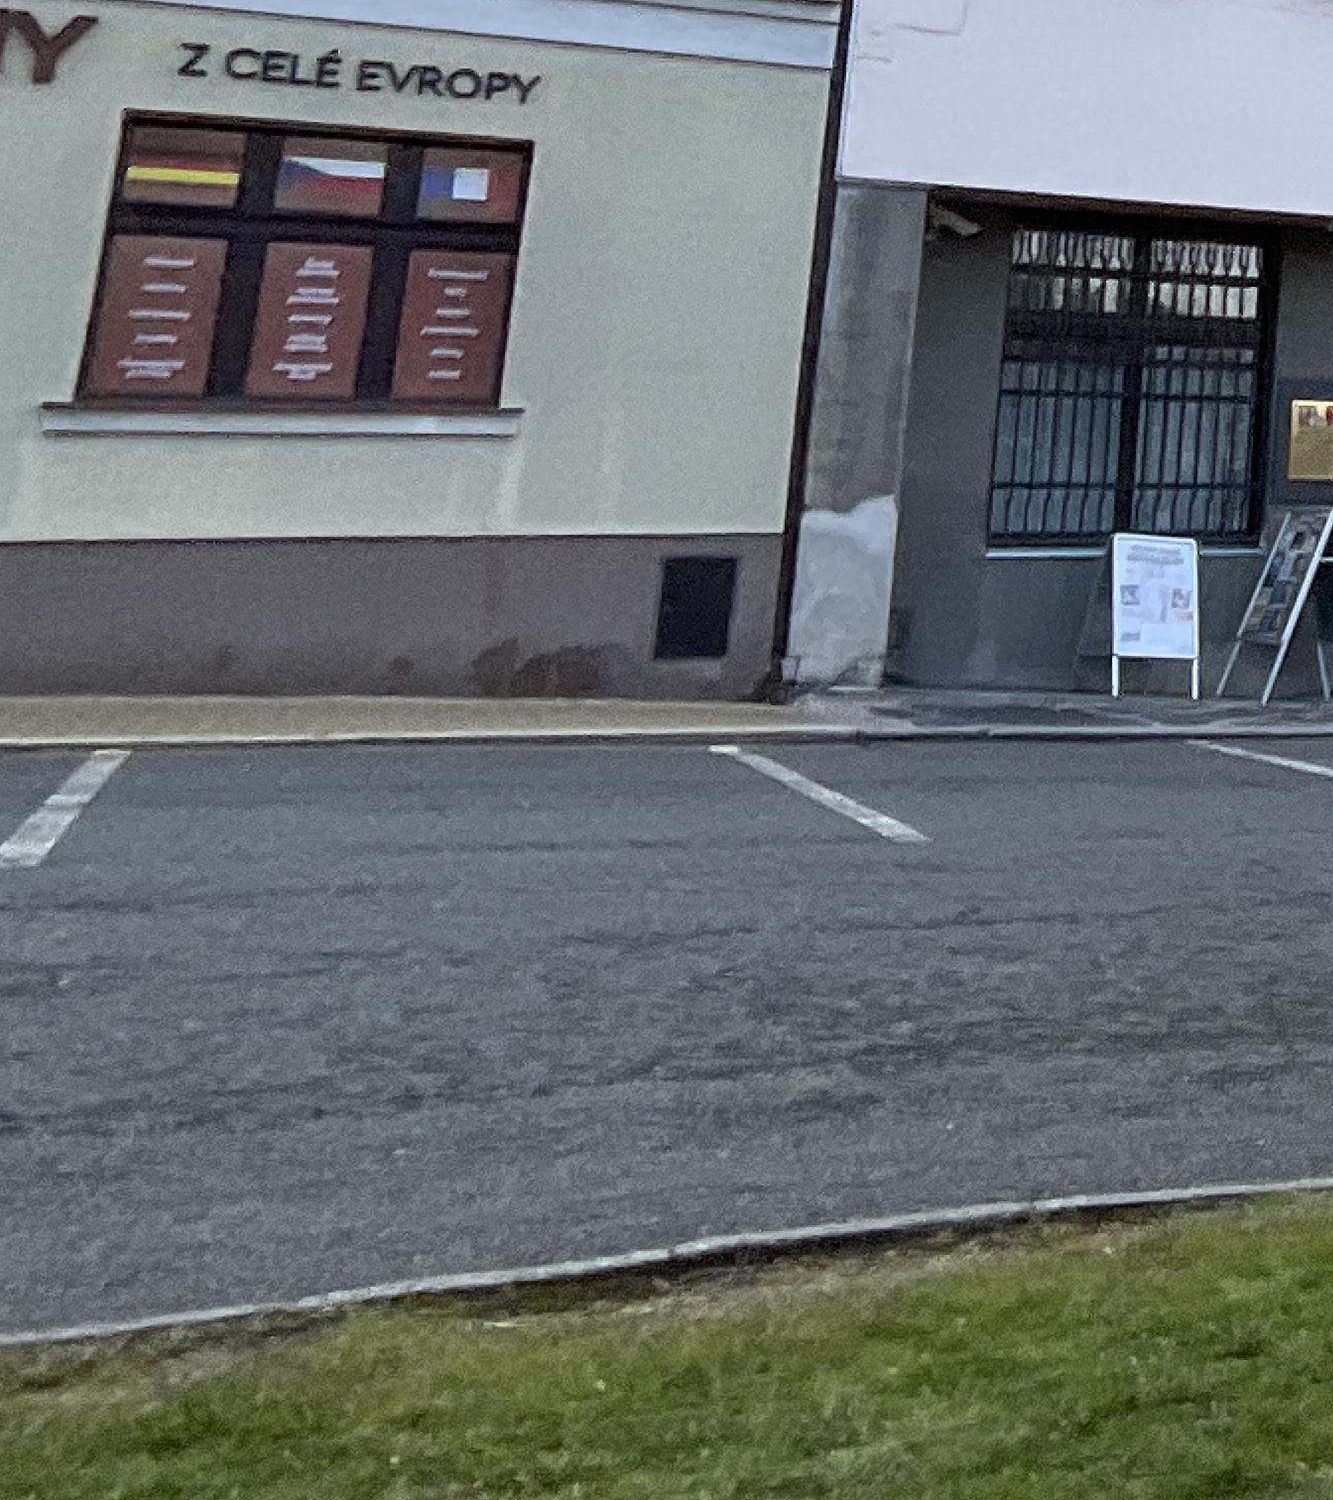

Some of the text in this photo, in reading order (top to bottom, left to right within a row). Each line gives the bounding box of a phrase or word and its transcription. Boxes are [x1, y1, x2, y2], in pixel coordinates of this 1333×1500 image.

[0, 9, 98, 84] Y
[177, 42, 542, 104] Z CELÉ EVROPY
